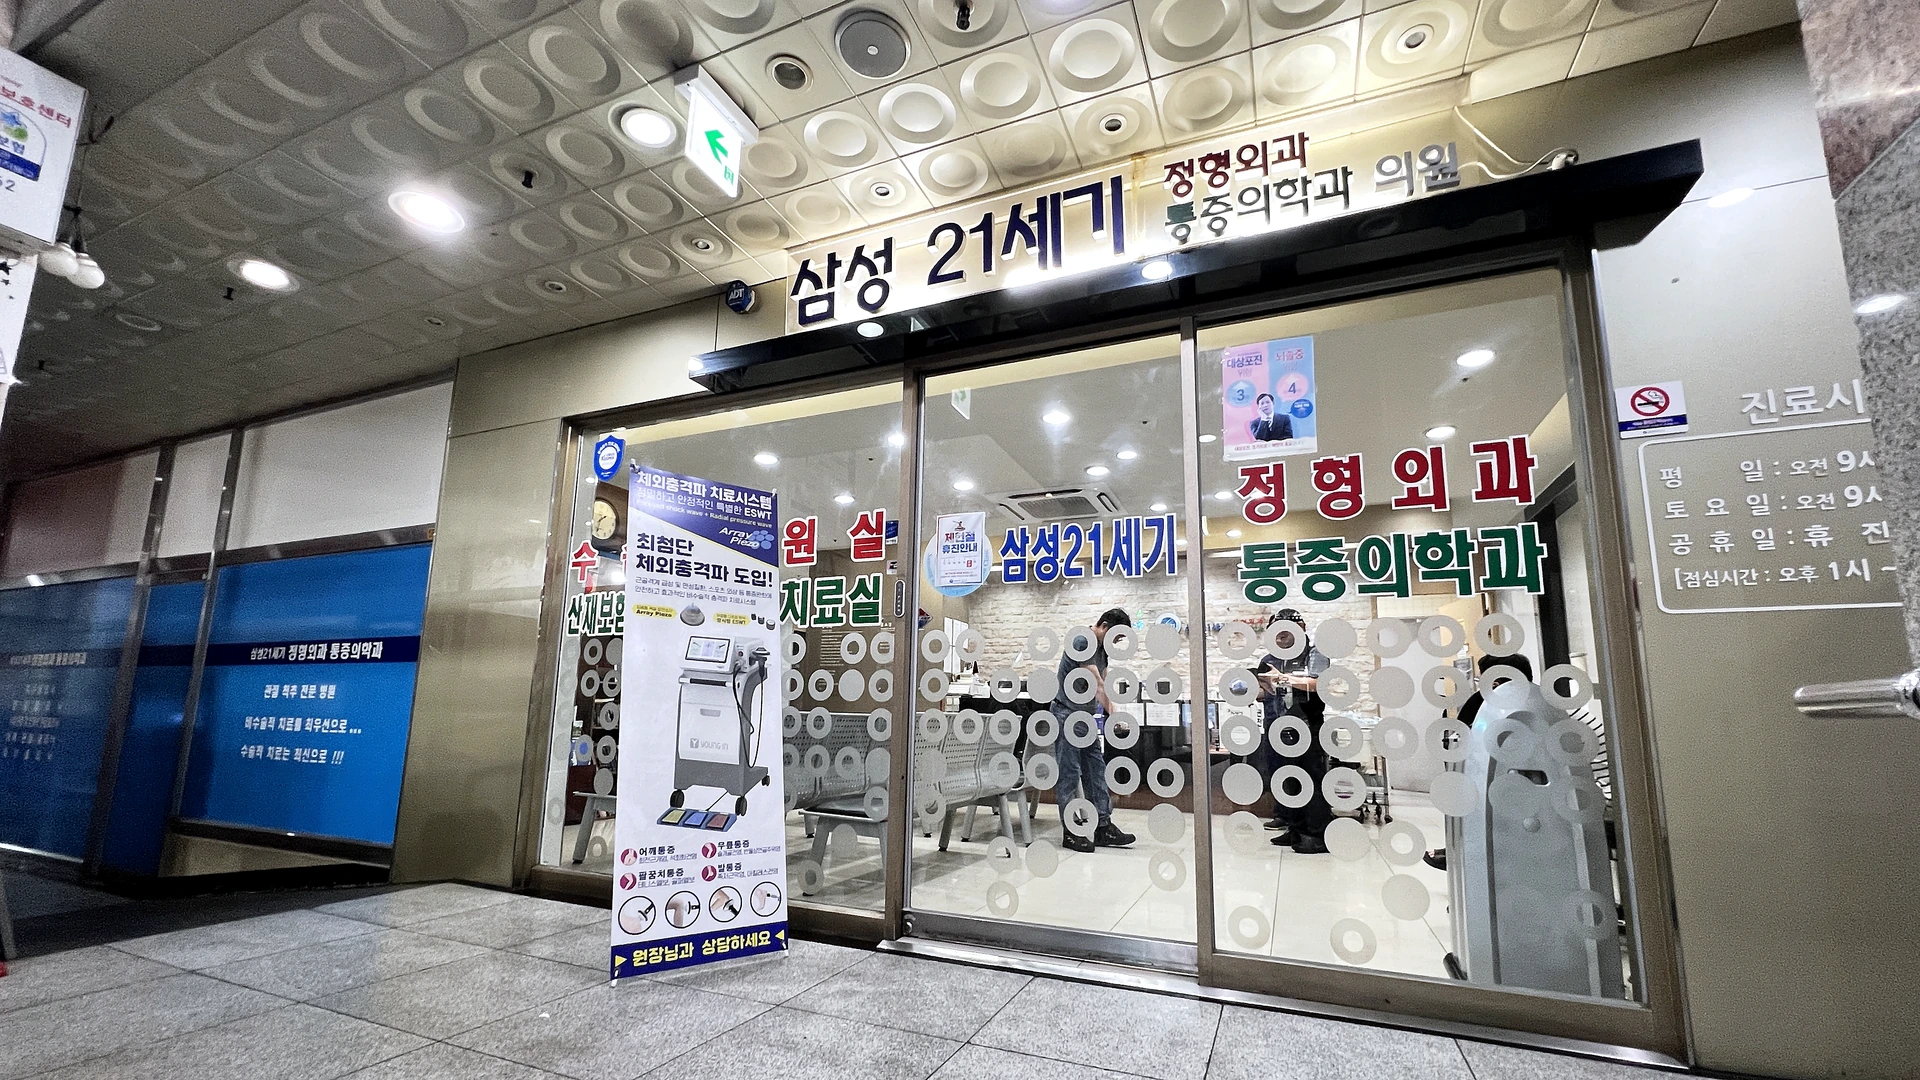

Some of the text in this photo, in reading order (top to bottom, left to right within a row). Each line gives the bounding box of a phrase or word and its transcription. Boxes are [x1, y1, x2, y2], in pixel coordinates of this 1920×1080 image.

[1164, 132, 1310, 199] 정형외과
[1164, 142, 1462, 245] 통증의학과 의원
[790, 174, 1126, 325] 삼성 21세기
[729, 289, 745, 300] ADT
[1226, 354, 1263, 369] 대상포진
[1236, 389, 1245, 401] 3
[1288, 382, 1297, 394] 4
[1741, 379, 1865, 425] 진료시
[1790, 458, 1829, 478] 오전
[637, 471, 772, 510] 체외충격파 치료시스템
[677, 494, 714, 510] 안정적인
[744, 507, 772, 520] ESWT
[1795, 492, 1836, 511] 오전
[666, 505, 685, 514] shock
[709, 512, 729, 521] Radial
[730, 517, 757, 526] pressure
[719, 527, 753, 540] Array
[730, 536, 760, 548] Piezo
[944, 531, 976, 543] 제헌절
[636, 532, 694, 557] 최첨단
[942, 542, 978, 554] 휴진안내
[999, 514, 1177, 583] 삼성21세기
[636, 553, 773, 588] 체외충격파 도입!
[1238, 523, 1547, 602] 통증의학과
[1779, 564, 1820, 583] 오후
[1828, 558, 1871, 582] 1시
[780, 573, 883, 626] 치료실
[636, 609, 653, 617] Array
[250, 641, 384, 661] 삼성21세기 정형외과 통증의학과
[282, 684, 298, 698] 척추
[300, 684, 317, 698] 전문
[319, 684, 337, 699] 병원
[293, 748, 328, 764] 최신으로
[639, 845, 676, 856] 어깨통증
[717, 839, 750, 850] 무릎통증
[638, 867, 685, 881] 팔꿈치통증
[717, 862, 742, 873] 발통증
[632, 930, 771, 968] 원장님과 상담하세요
